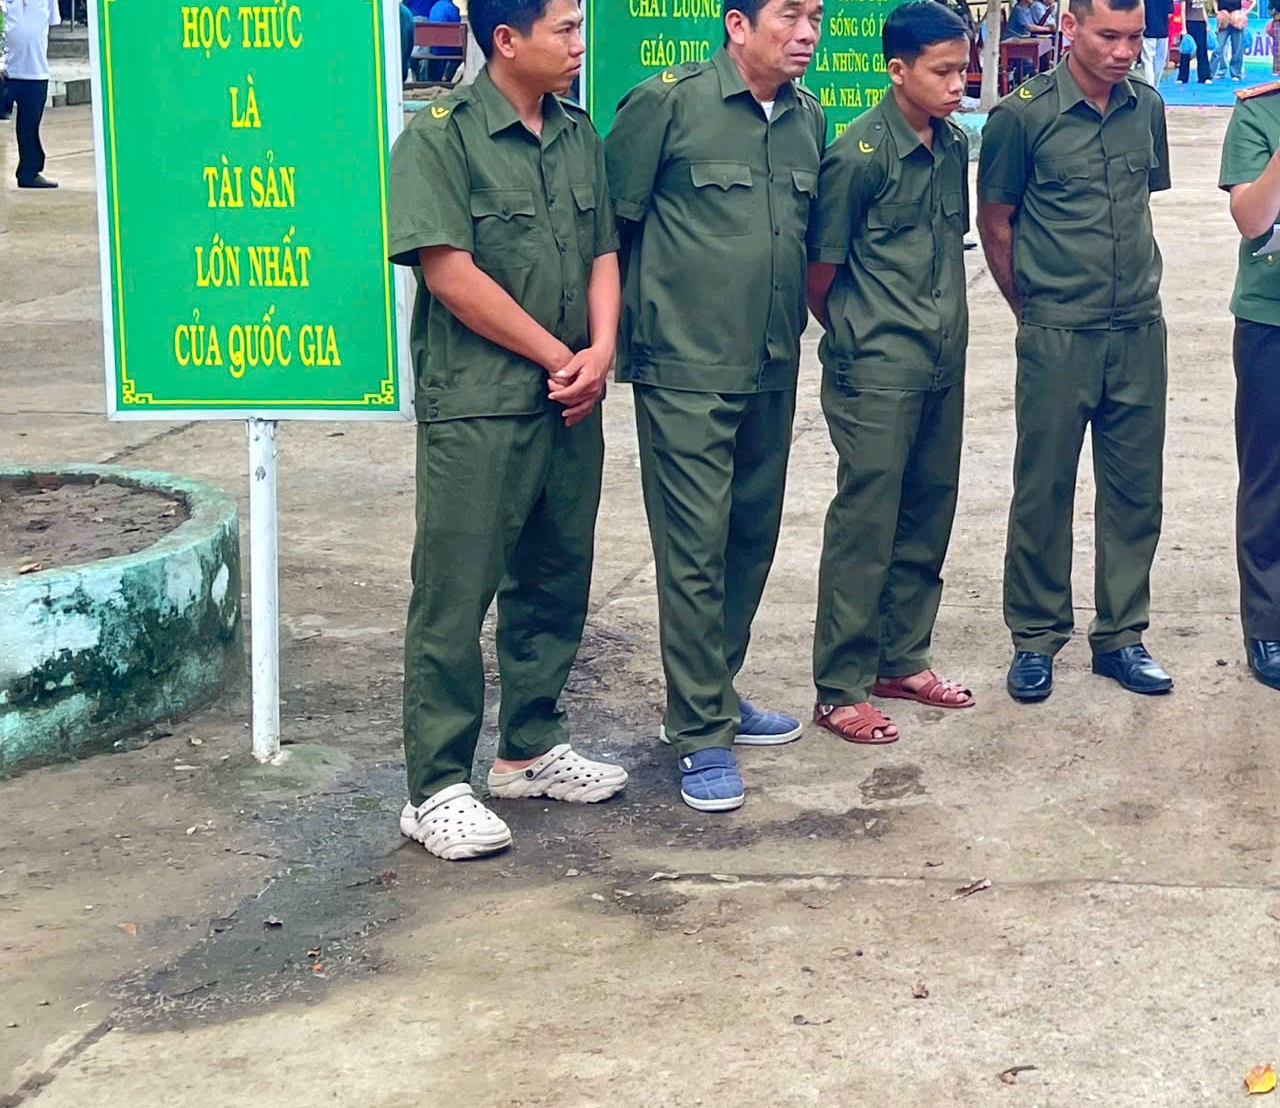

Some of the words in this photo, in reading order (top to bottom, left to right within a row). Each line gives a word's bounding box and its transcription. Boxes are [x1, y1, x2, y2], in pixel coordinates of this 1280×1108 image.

[182, 6, 231, 58] HỌC
[830, 8, 859, 37] SỐNG
[861, 12, 876, 37] CÓ
[640, 33, 676, 67] GIÁO
[815, 47, 829, 71] LÀ
[832, 48, 870, 72] NHỮNG
[230, 75, 261, 128] LÀ
[820, 83, 836, 106] MÀ
[840, 82, 862, 107] NHÀ
[203, 155, 243, 208] TÀI
[250, 150, 295, 208] SẢN
[195, 233, 240, 287] LỚN
[248, 226, 310, 287] NHẤT
[175, 308, 222, 366] CỦA
[228, 305, 291, 378] QUỐC
[299, 324, 341, 366] GIA
